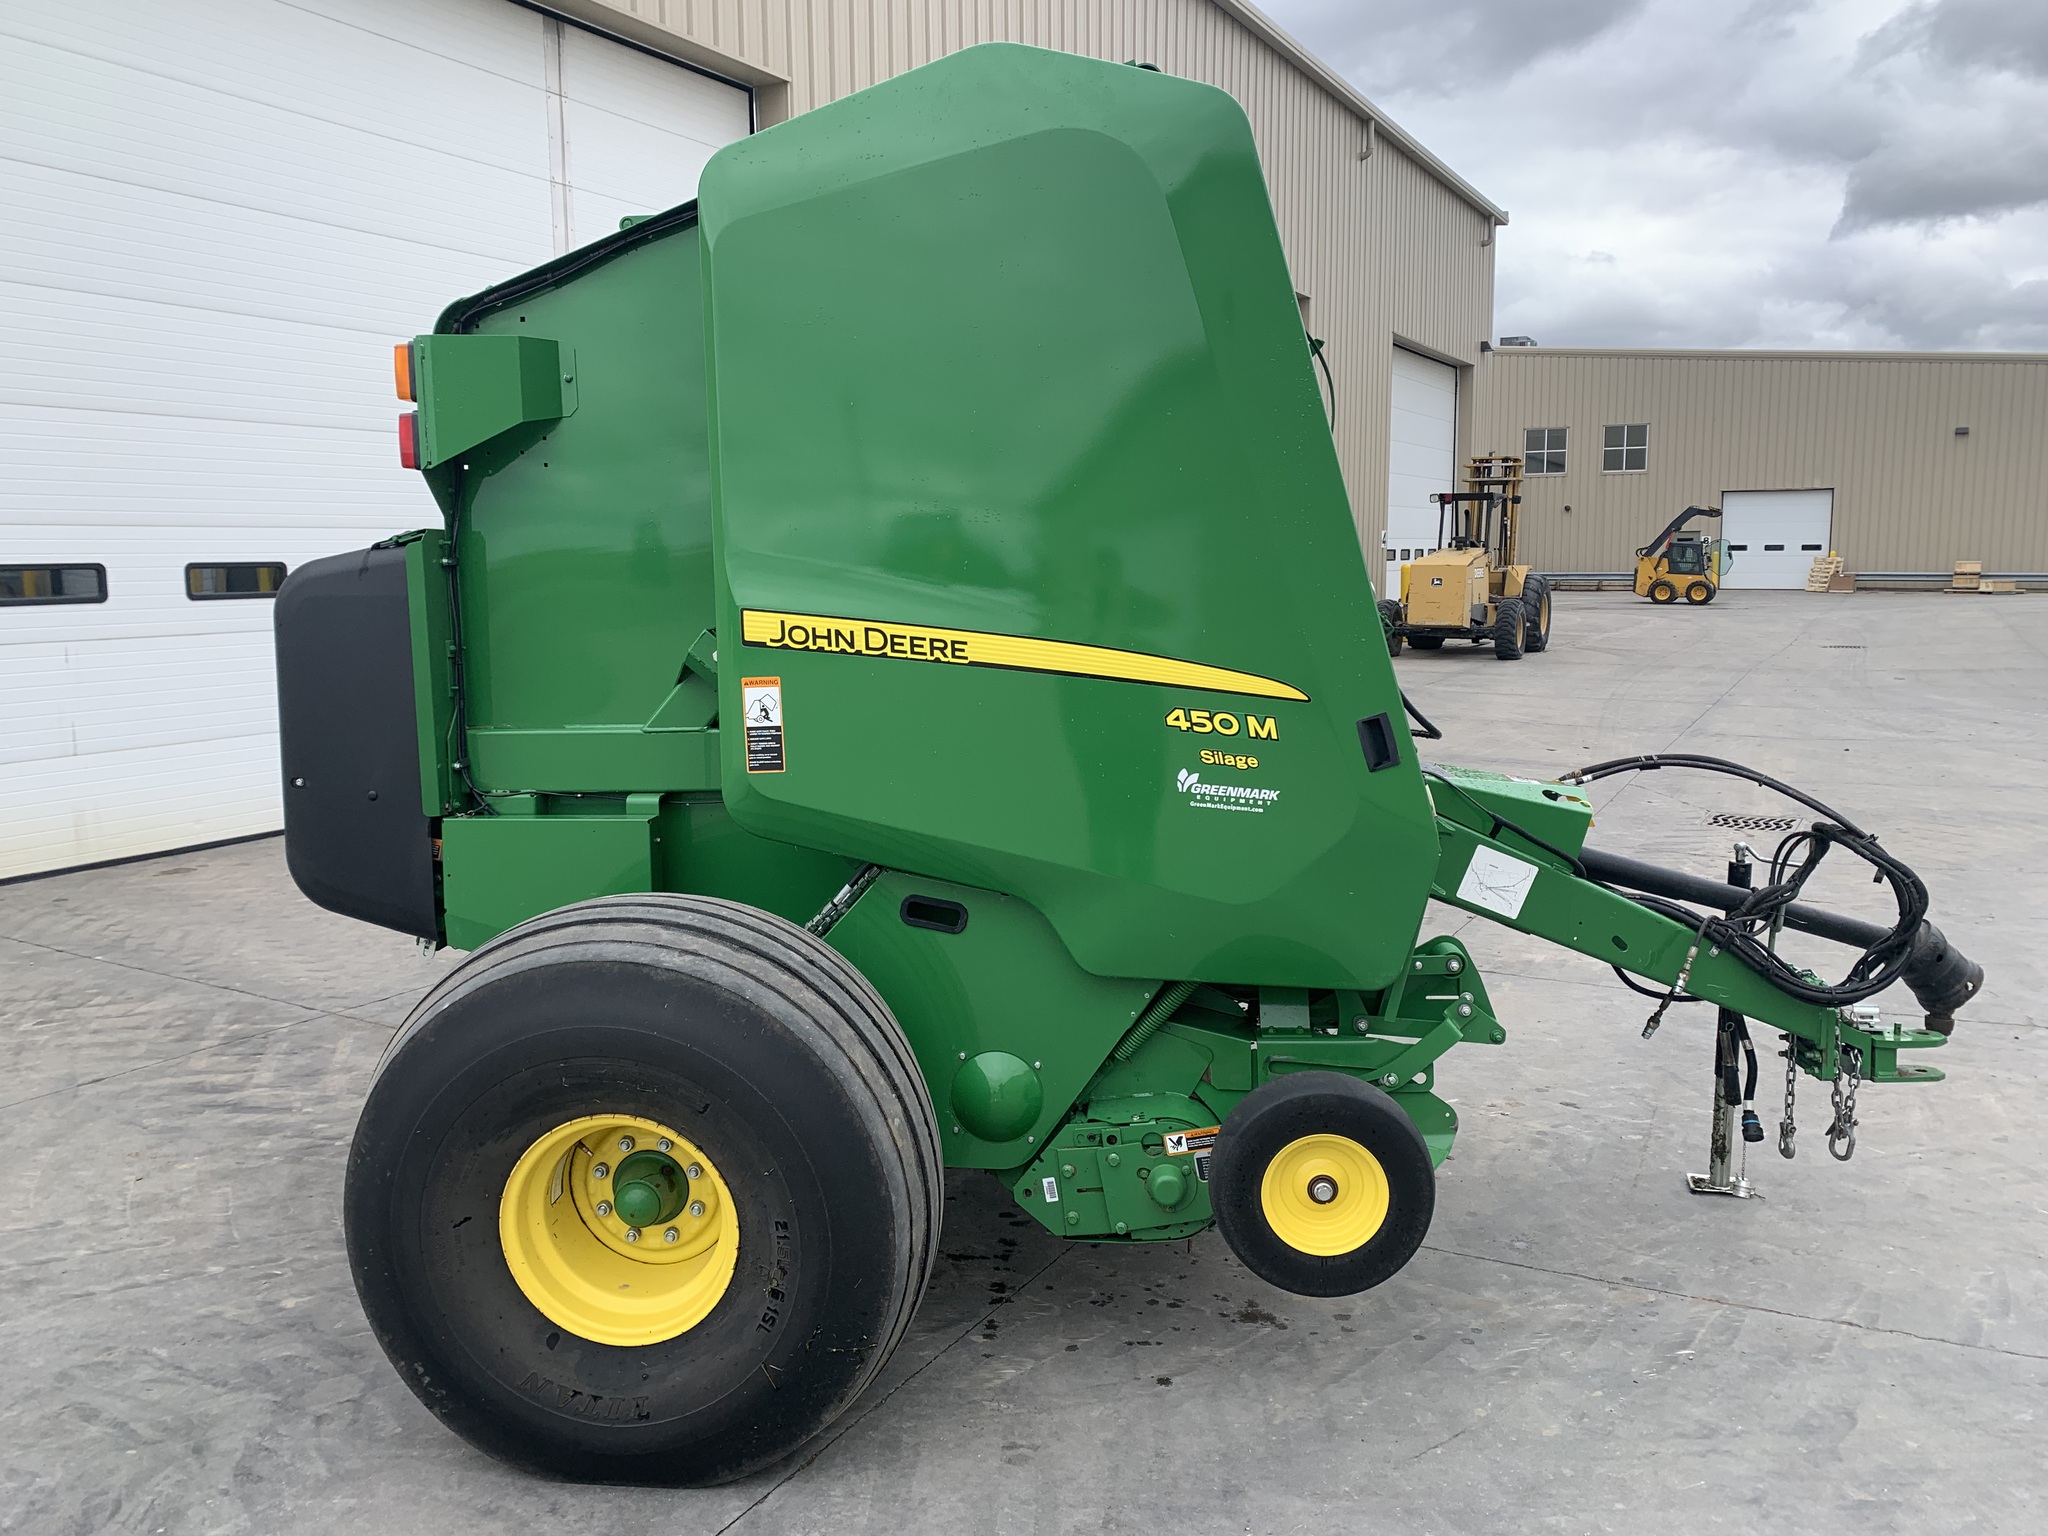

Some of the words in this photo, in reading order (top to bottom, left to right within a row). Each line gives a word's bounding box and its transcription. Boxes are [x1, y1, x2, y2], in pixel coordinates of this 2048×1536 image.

[770, 620, 855, 649] JOHN
[864, 627, 968, 660] DEERE
[1165, 707, 1240, 736] 450
[1245, 714, 1279, 741] M
[1199, 749, 1259, 771] Silage
[1191, 783, 1281, 801] GREENMARK
[1196, 795, 1272, 806] EQUIPMENT
[1189, 801, 1264, 813] GreenMarkEquipment.com
[516, 1370, 651, 1422] TITAN
